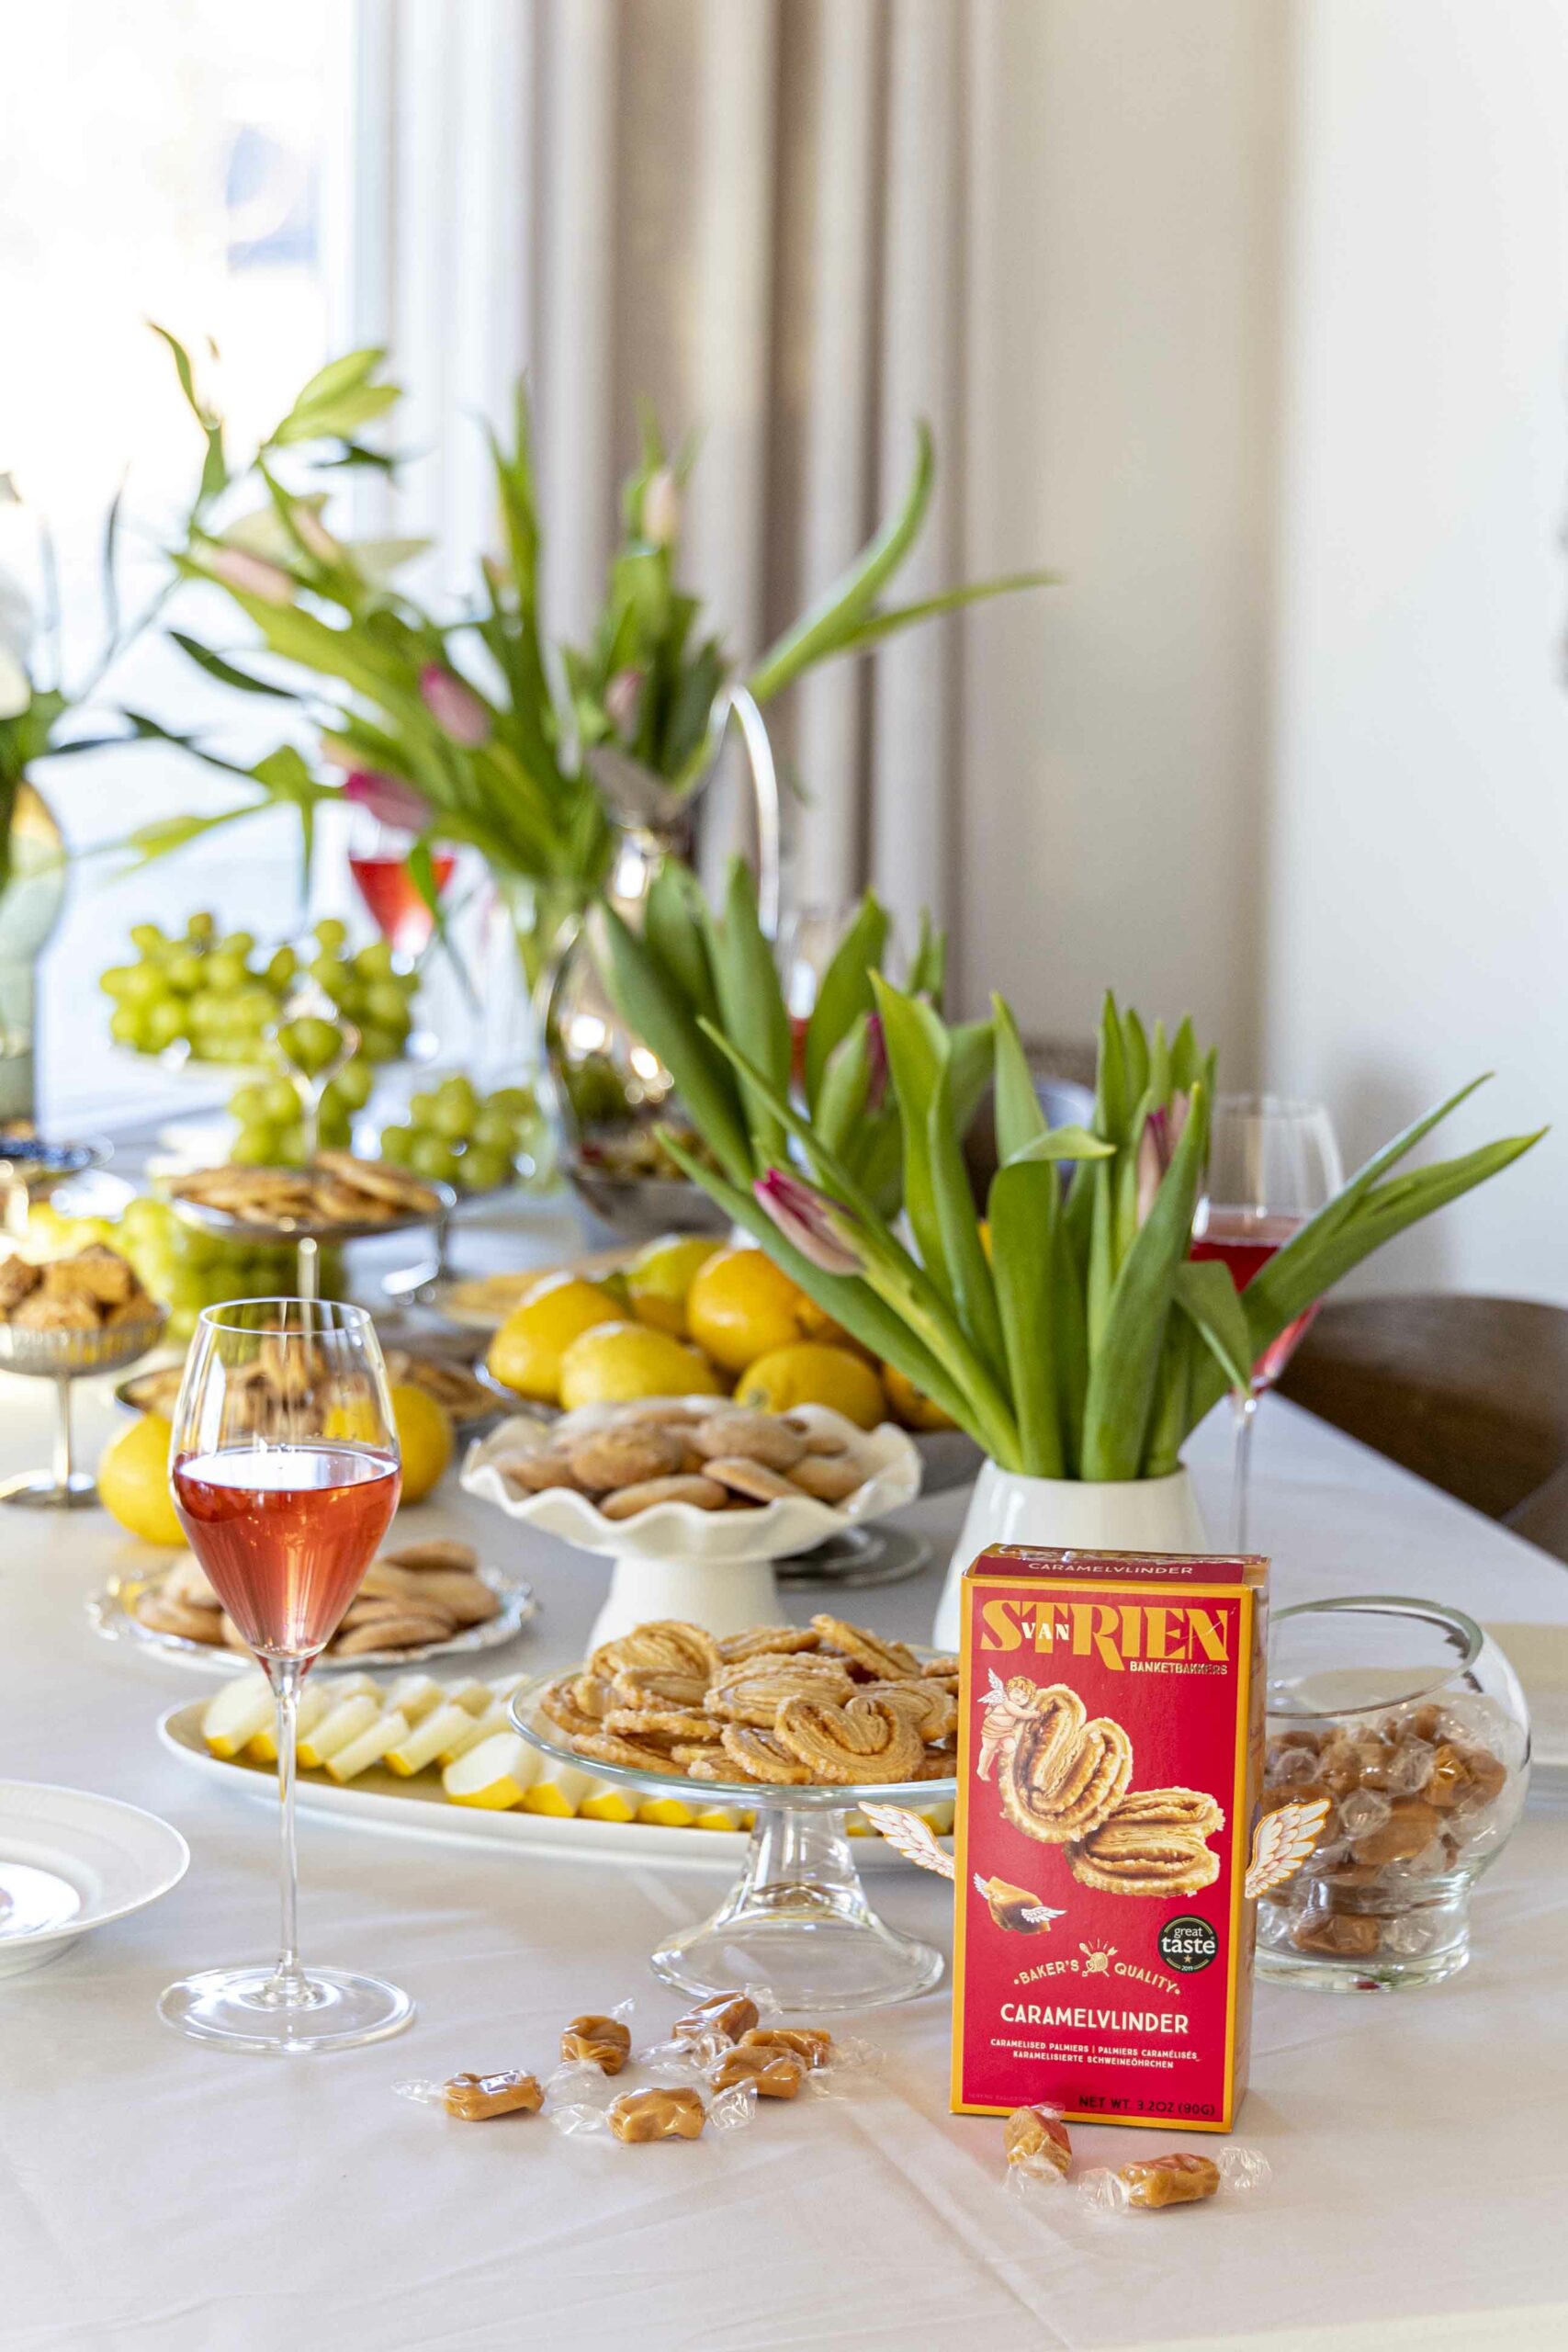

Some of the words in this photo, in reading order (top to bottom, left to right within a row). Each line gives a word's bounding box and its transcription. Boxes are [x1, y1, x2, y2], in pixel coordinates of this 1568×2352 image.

[1028, 1563, 1193, 1574] CARAMELVLINDER
[981, 1600, 1229, 1670] STRIEN
[1021, 1622, 1069, 1641] VAN
[1129, 1660, 1228, 1675] BANKETBAKKERS
[1173, 1927, 1203, 1939] great
[1161, 1936, 1216, 1954] taste
[1018, 1959, 1080, 1984] BAKER'S
[1113, 1962, 1179, 1994] QUALITY
[999, 2003, 1190, 2034] CARAMELVLINDER
[990, 2038, 1046, 2050] CARAMELISED
[1048, 2042, 1089, 2053] PALMIERS
[1098, 2046, 1138, 2057] PALMIERS
[1141, 2048, 1198, 2060] CARAMÉLISÉS
[1012, 2050, 1084, 2064] KARAMELISIERTE
[1087, 2054, 1175, 2069] SCHWEINEÖHRCHEN
[1078, 2096, 1106, 2109] NET
[1178, 2102, 1215, 2116] (90G)
